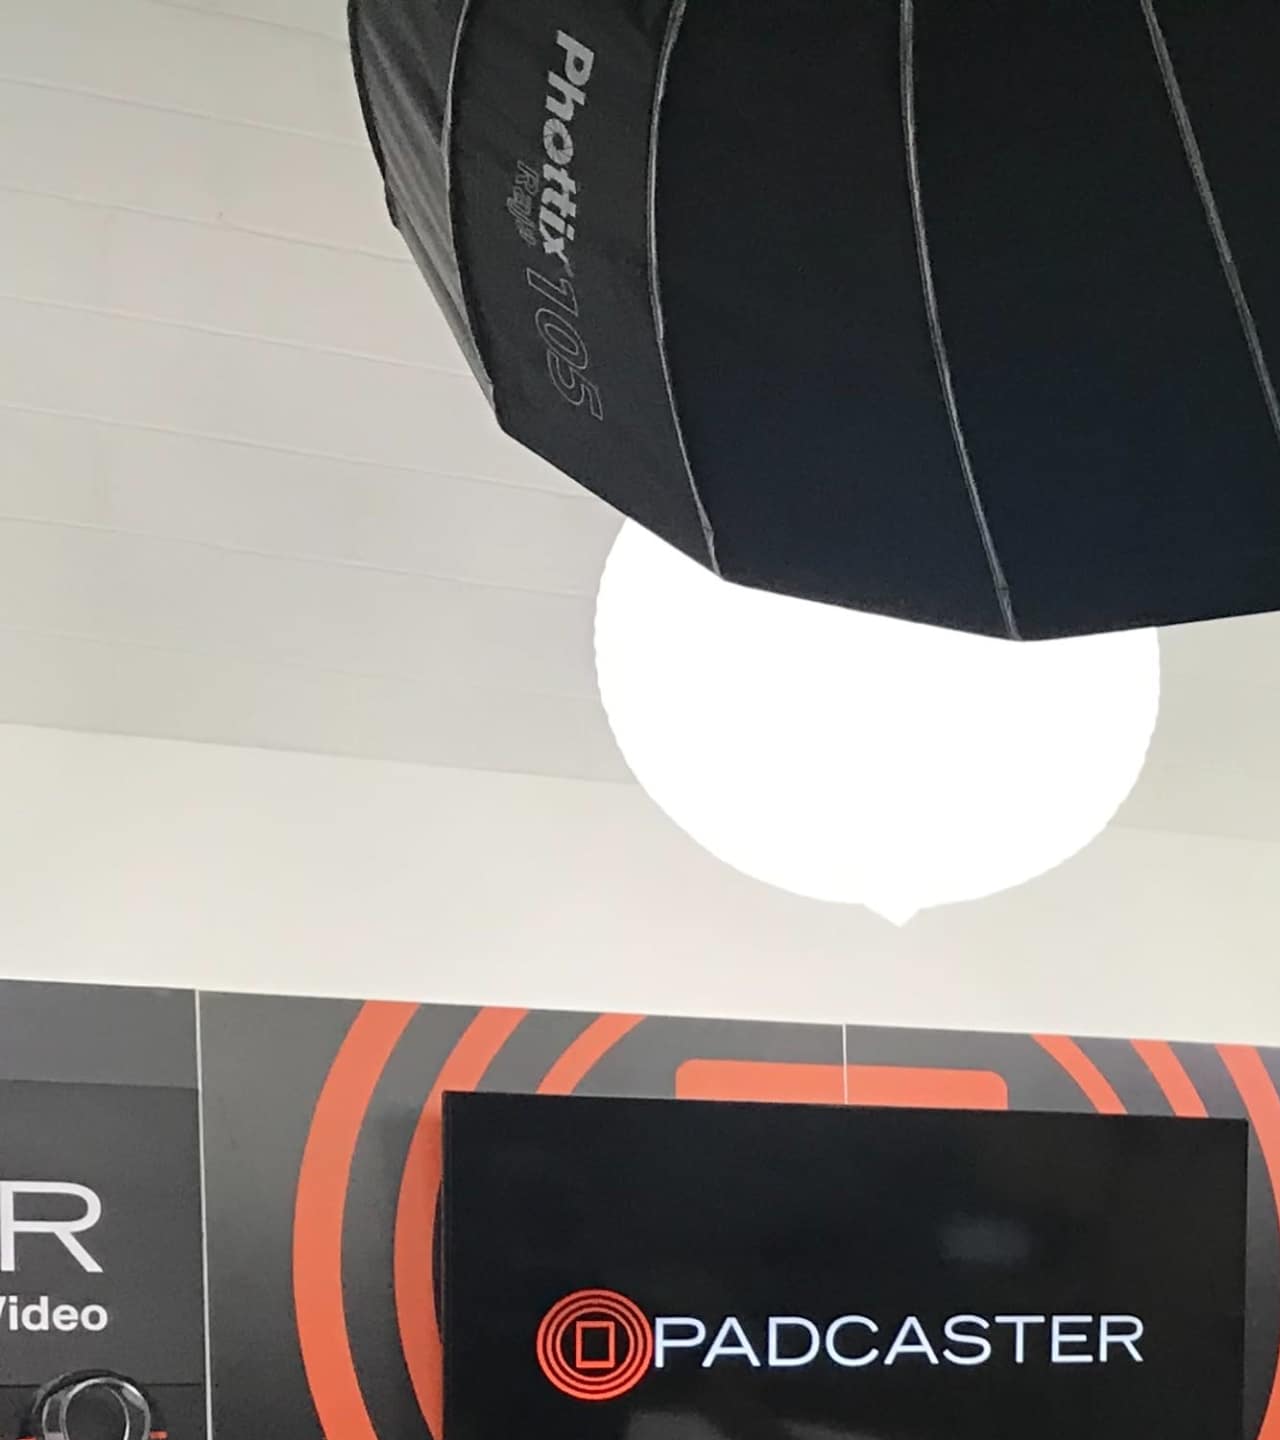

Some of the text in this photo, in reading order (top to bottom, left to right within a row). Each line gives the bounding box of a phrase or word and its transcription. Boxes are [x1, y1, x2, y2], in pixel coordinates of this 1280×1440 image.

[526, 30, 603, 421] Phottix 105
[653, 1314, 1144, 1368] PADCASTER
